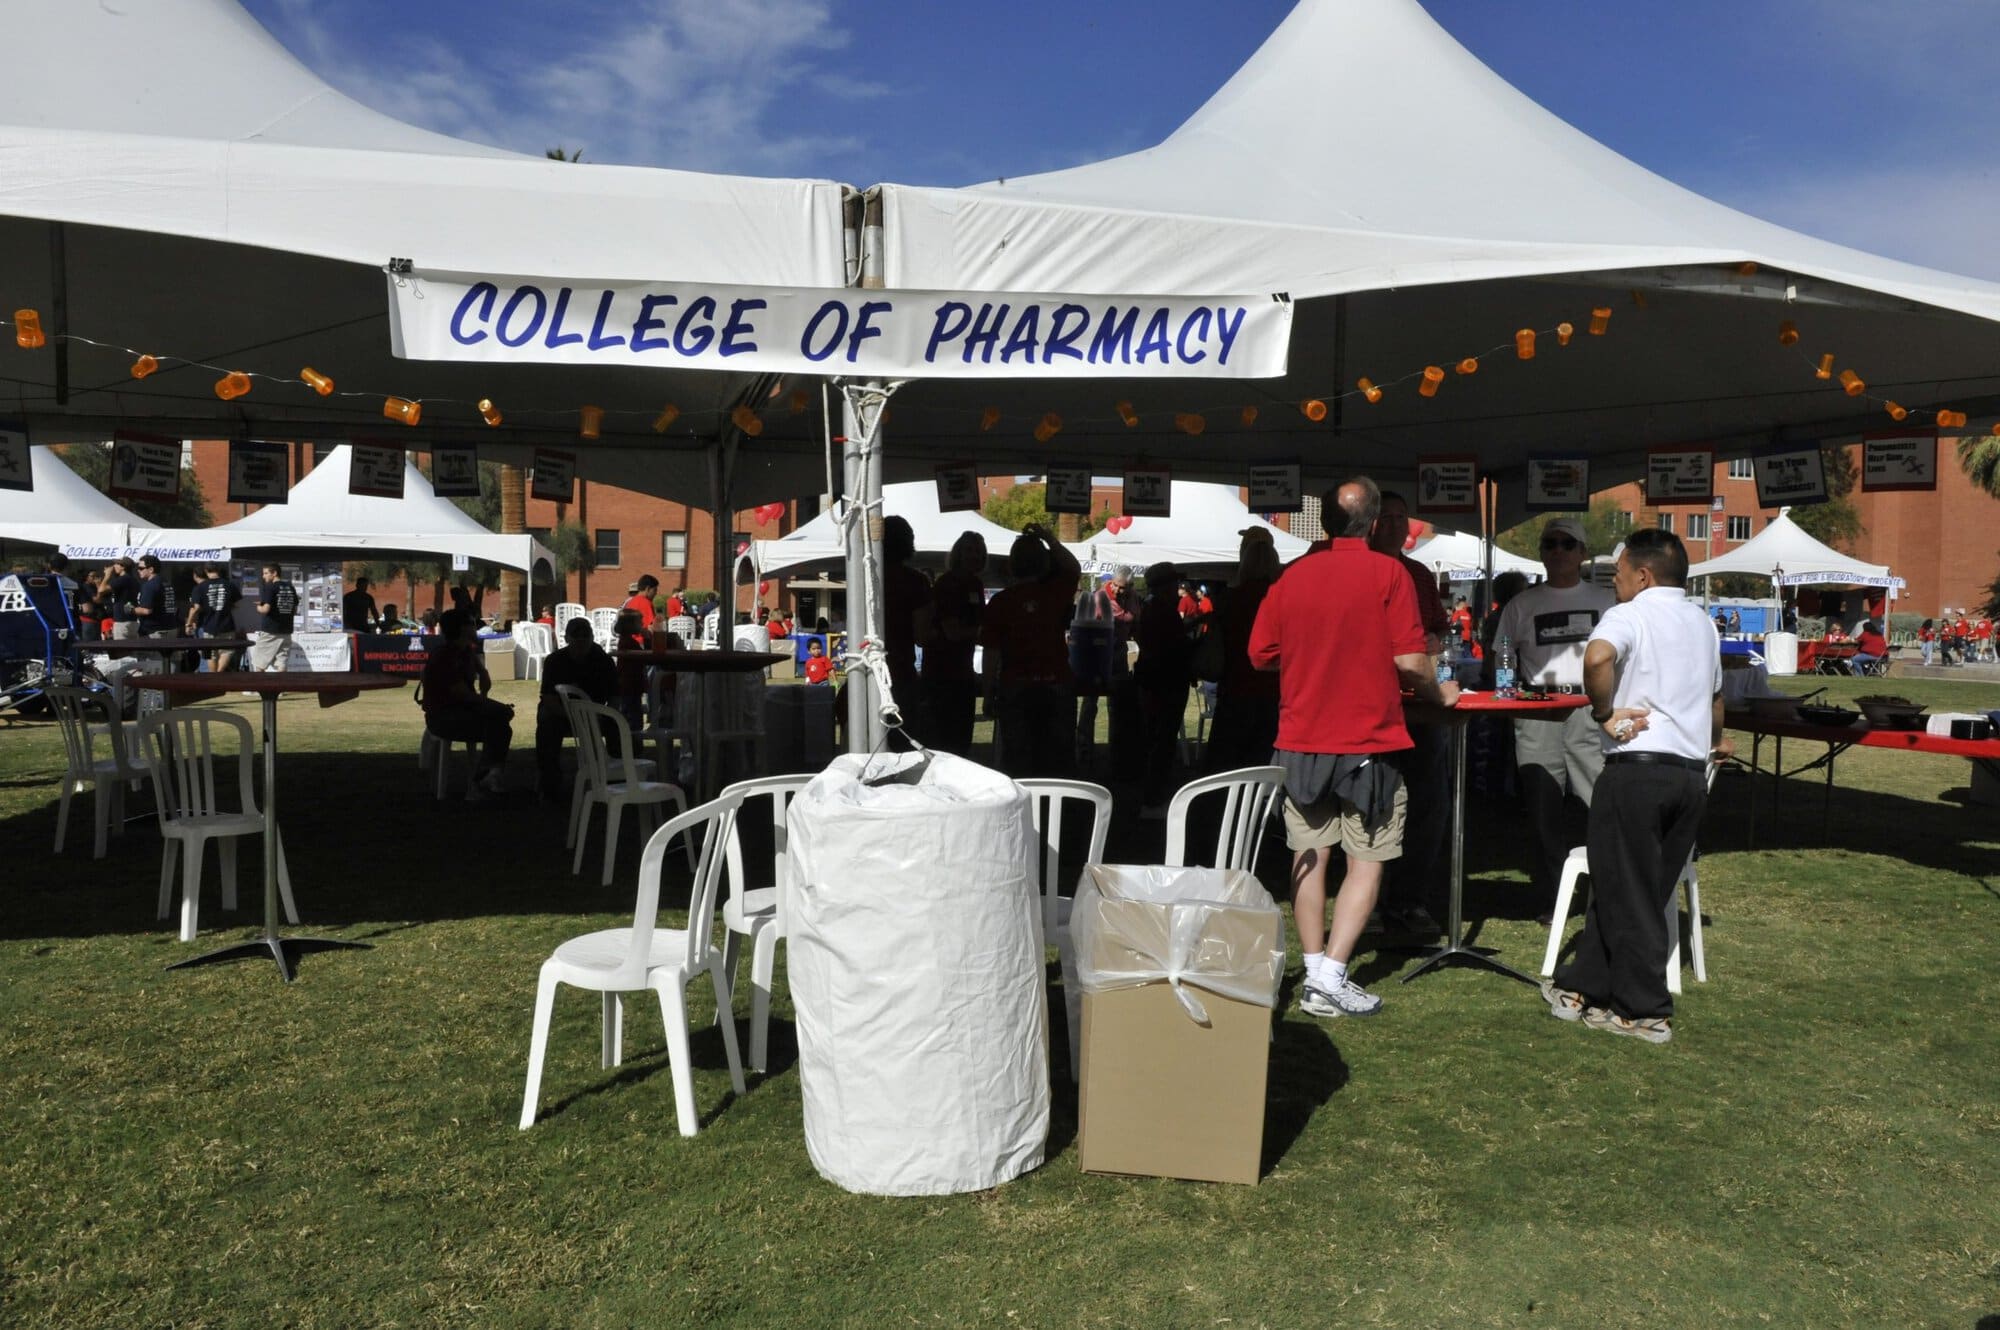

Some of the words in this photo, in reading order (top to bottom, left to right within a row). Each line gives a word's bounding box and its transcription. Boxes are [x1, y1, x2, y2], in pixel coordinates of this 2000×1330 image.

[451, 283, 766, 356] COLLEGE
[803, 303, 892, 362] OF
[925, 303, 1247, 364] PHARMACY
[67, 546, 119, 557] COLLEGE
[124, 547, 140, 558] OF
[146, 548, 221, 560] ENGINEERING
[1082, 561, 1096, 571] OF
[364, 652, 399, 661] MINING
